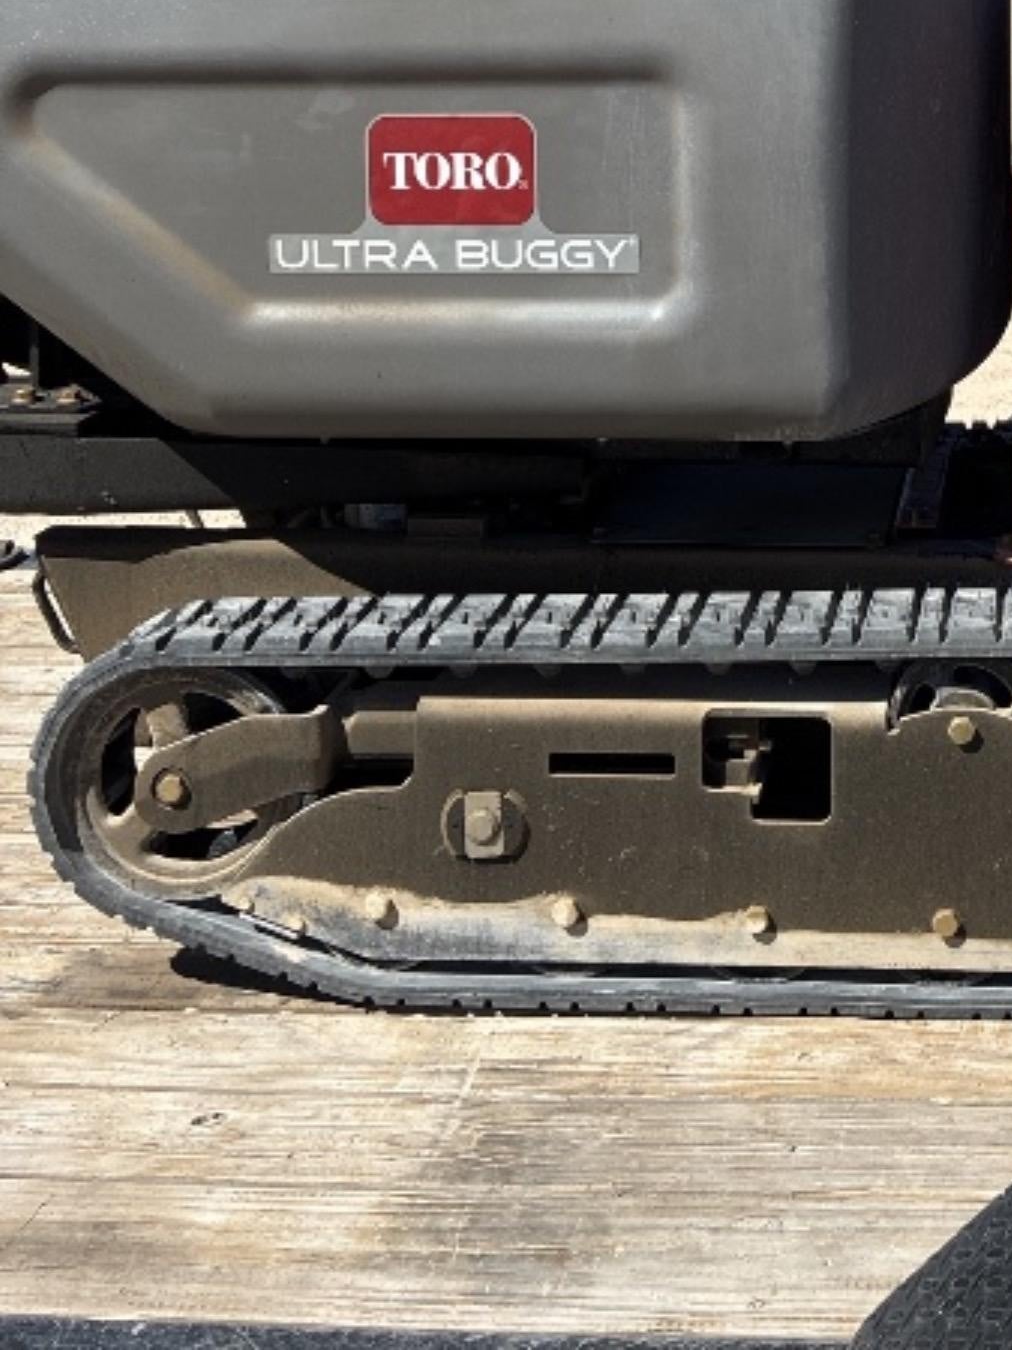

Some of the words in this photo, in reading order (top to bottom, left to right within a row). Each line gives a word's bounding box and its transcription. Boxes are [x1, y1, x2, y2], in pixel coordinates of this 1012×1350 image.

[384, 152, 522, 191] TORO
[275, 238, 439, 270] ULTRA
[455, 238, 625, 271] BUGGY
